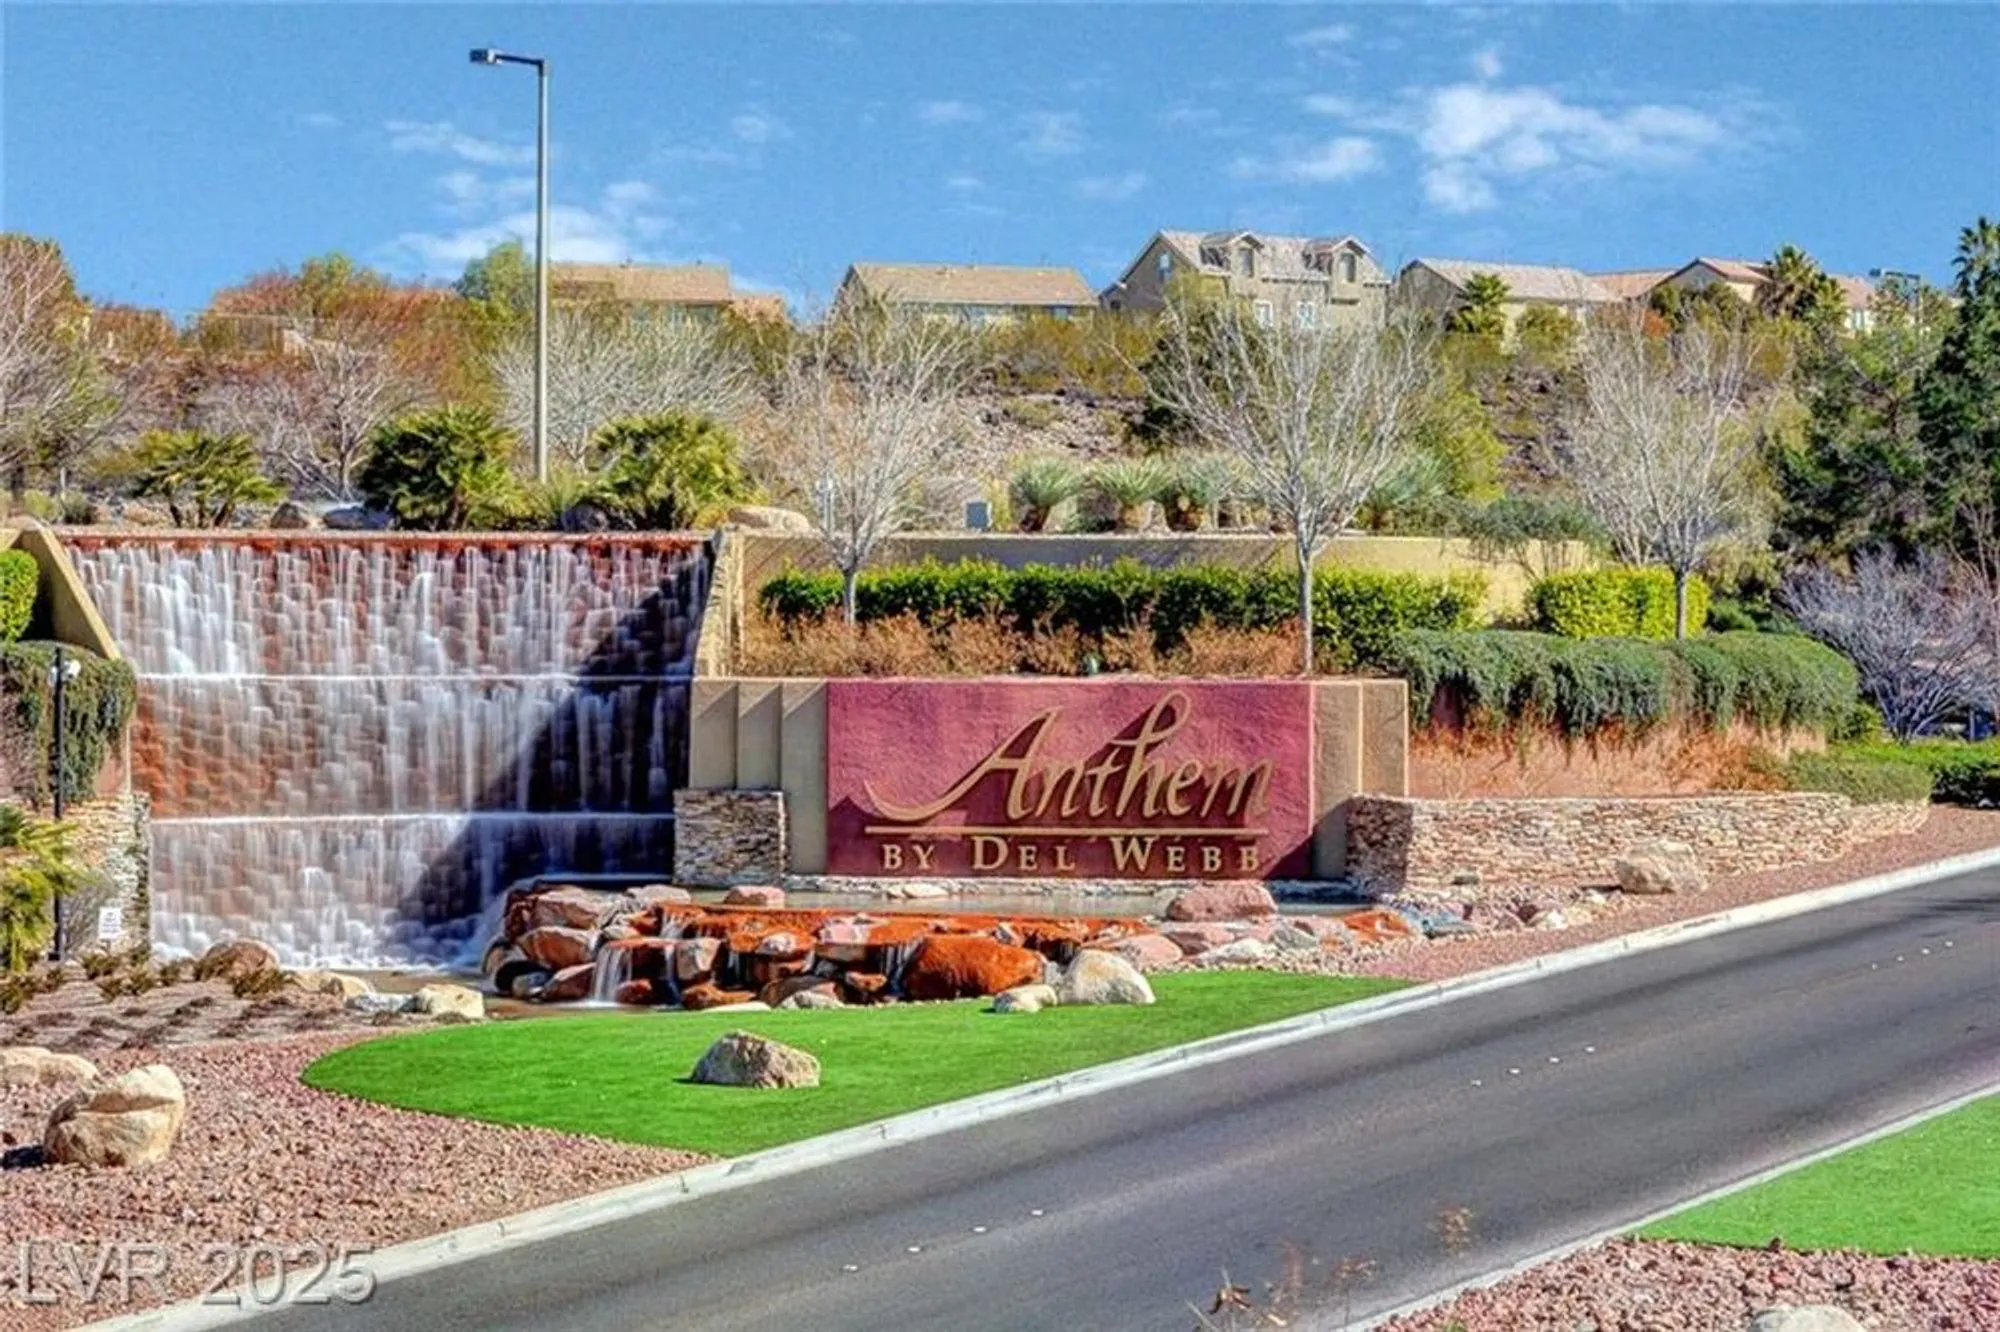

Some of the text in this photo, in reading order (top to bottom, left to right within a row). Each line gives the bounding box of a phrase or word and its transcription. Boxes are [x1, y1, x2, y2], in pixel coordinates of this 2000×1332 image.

[863, 690, 1276, 822] Anthem
[882, 835, 1259, 872] BY DEL WEBB
